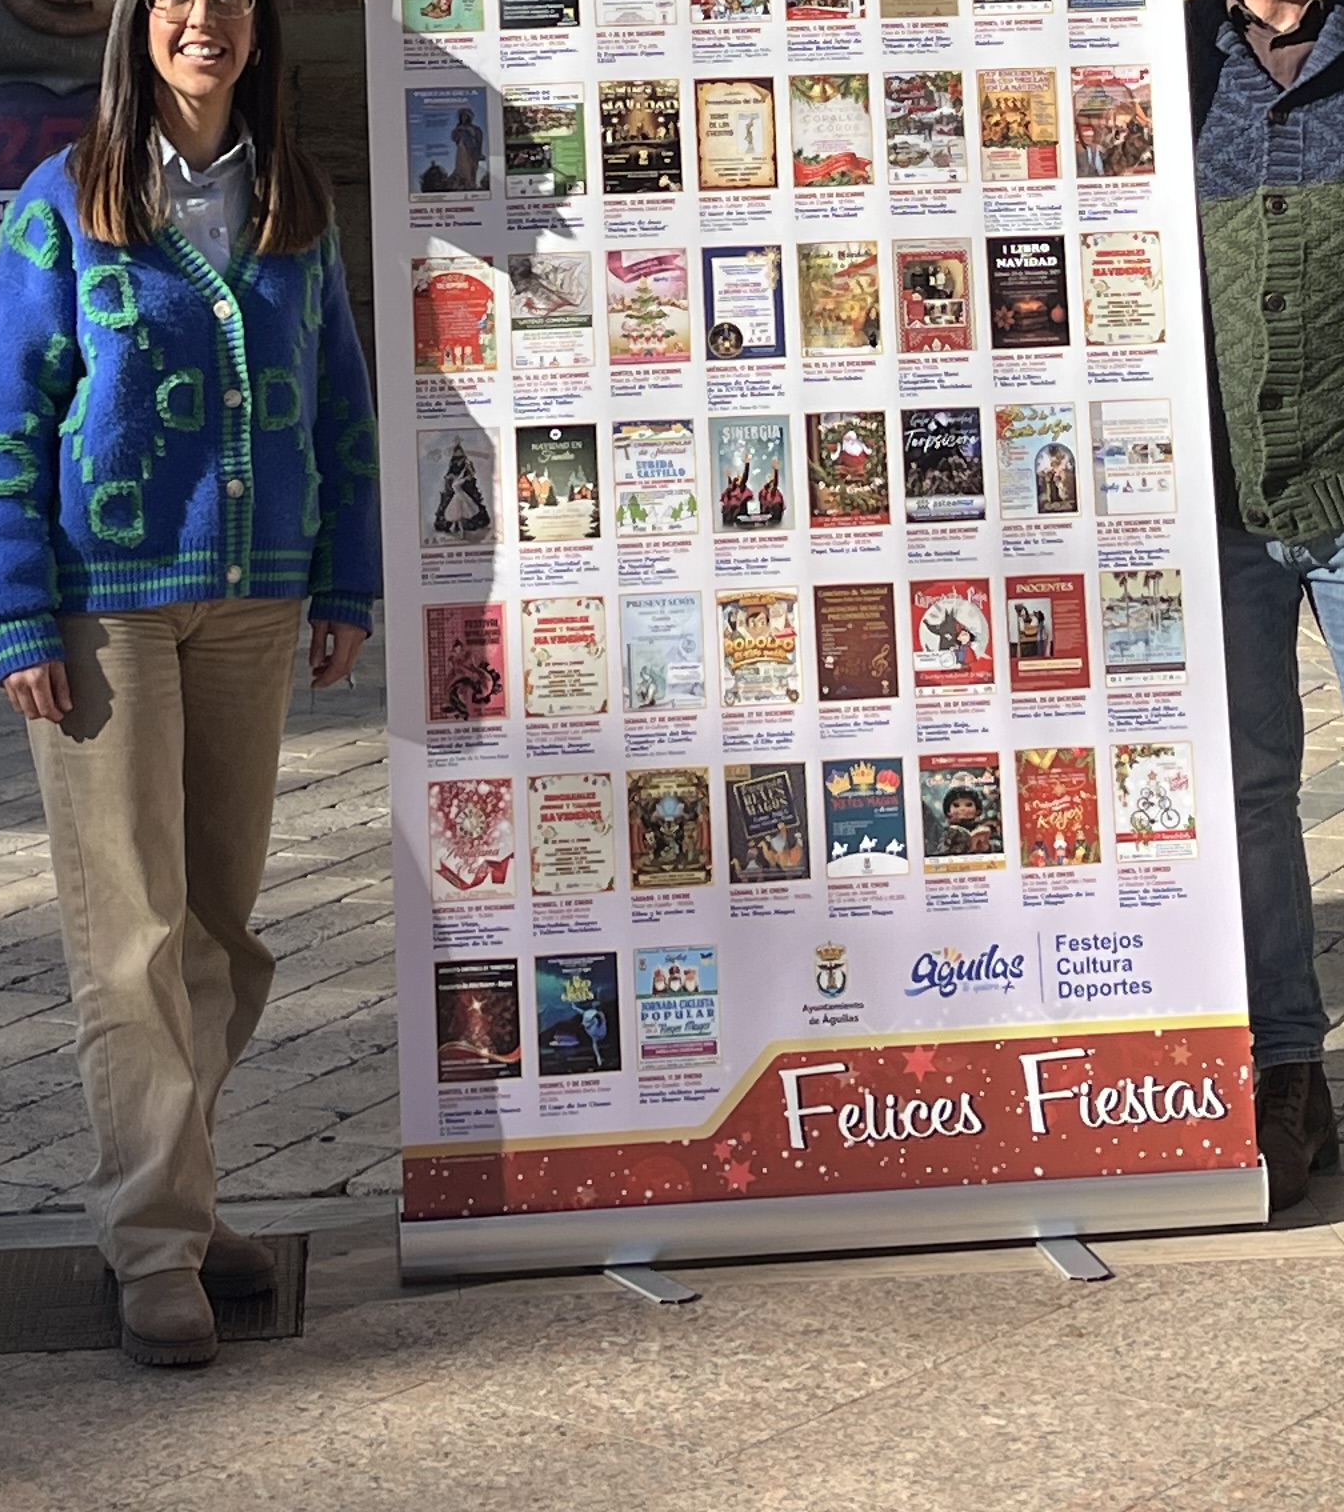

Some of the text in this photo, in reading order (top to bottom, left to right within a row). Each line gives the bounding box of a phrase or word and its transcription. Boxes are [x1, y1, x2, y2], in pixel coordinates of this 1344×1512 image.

[1010, 243, 1050, 254] LIBRO
[996, 257, 1057, 268] NAVIDAD
[722, 425, 781, 440] SINERGIA
[636, 461, 674, 469] SUBIDA
[636, 468, 686, 478] CASTILLO
[1016, 582, 1074, 594] INOCENTES
[1055, 932, 1143, 954] Festejos
[1056, 956, 1133, 975] Cultura
[1058, 978, 1153, 1002] Deportes
[803, 1002, 864, 1013] Ayuntamiento
[641, 1009, 715, 1022] POPULAR
[809, 1013, 859, 1026] de Águilas
[778, 1047, 1229, 1149] Felices Fiestas
